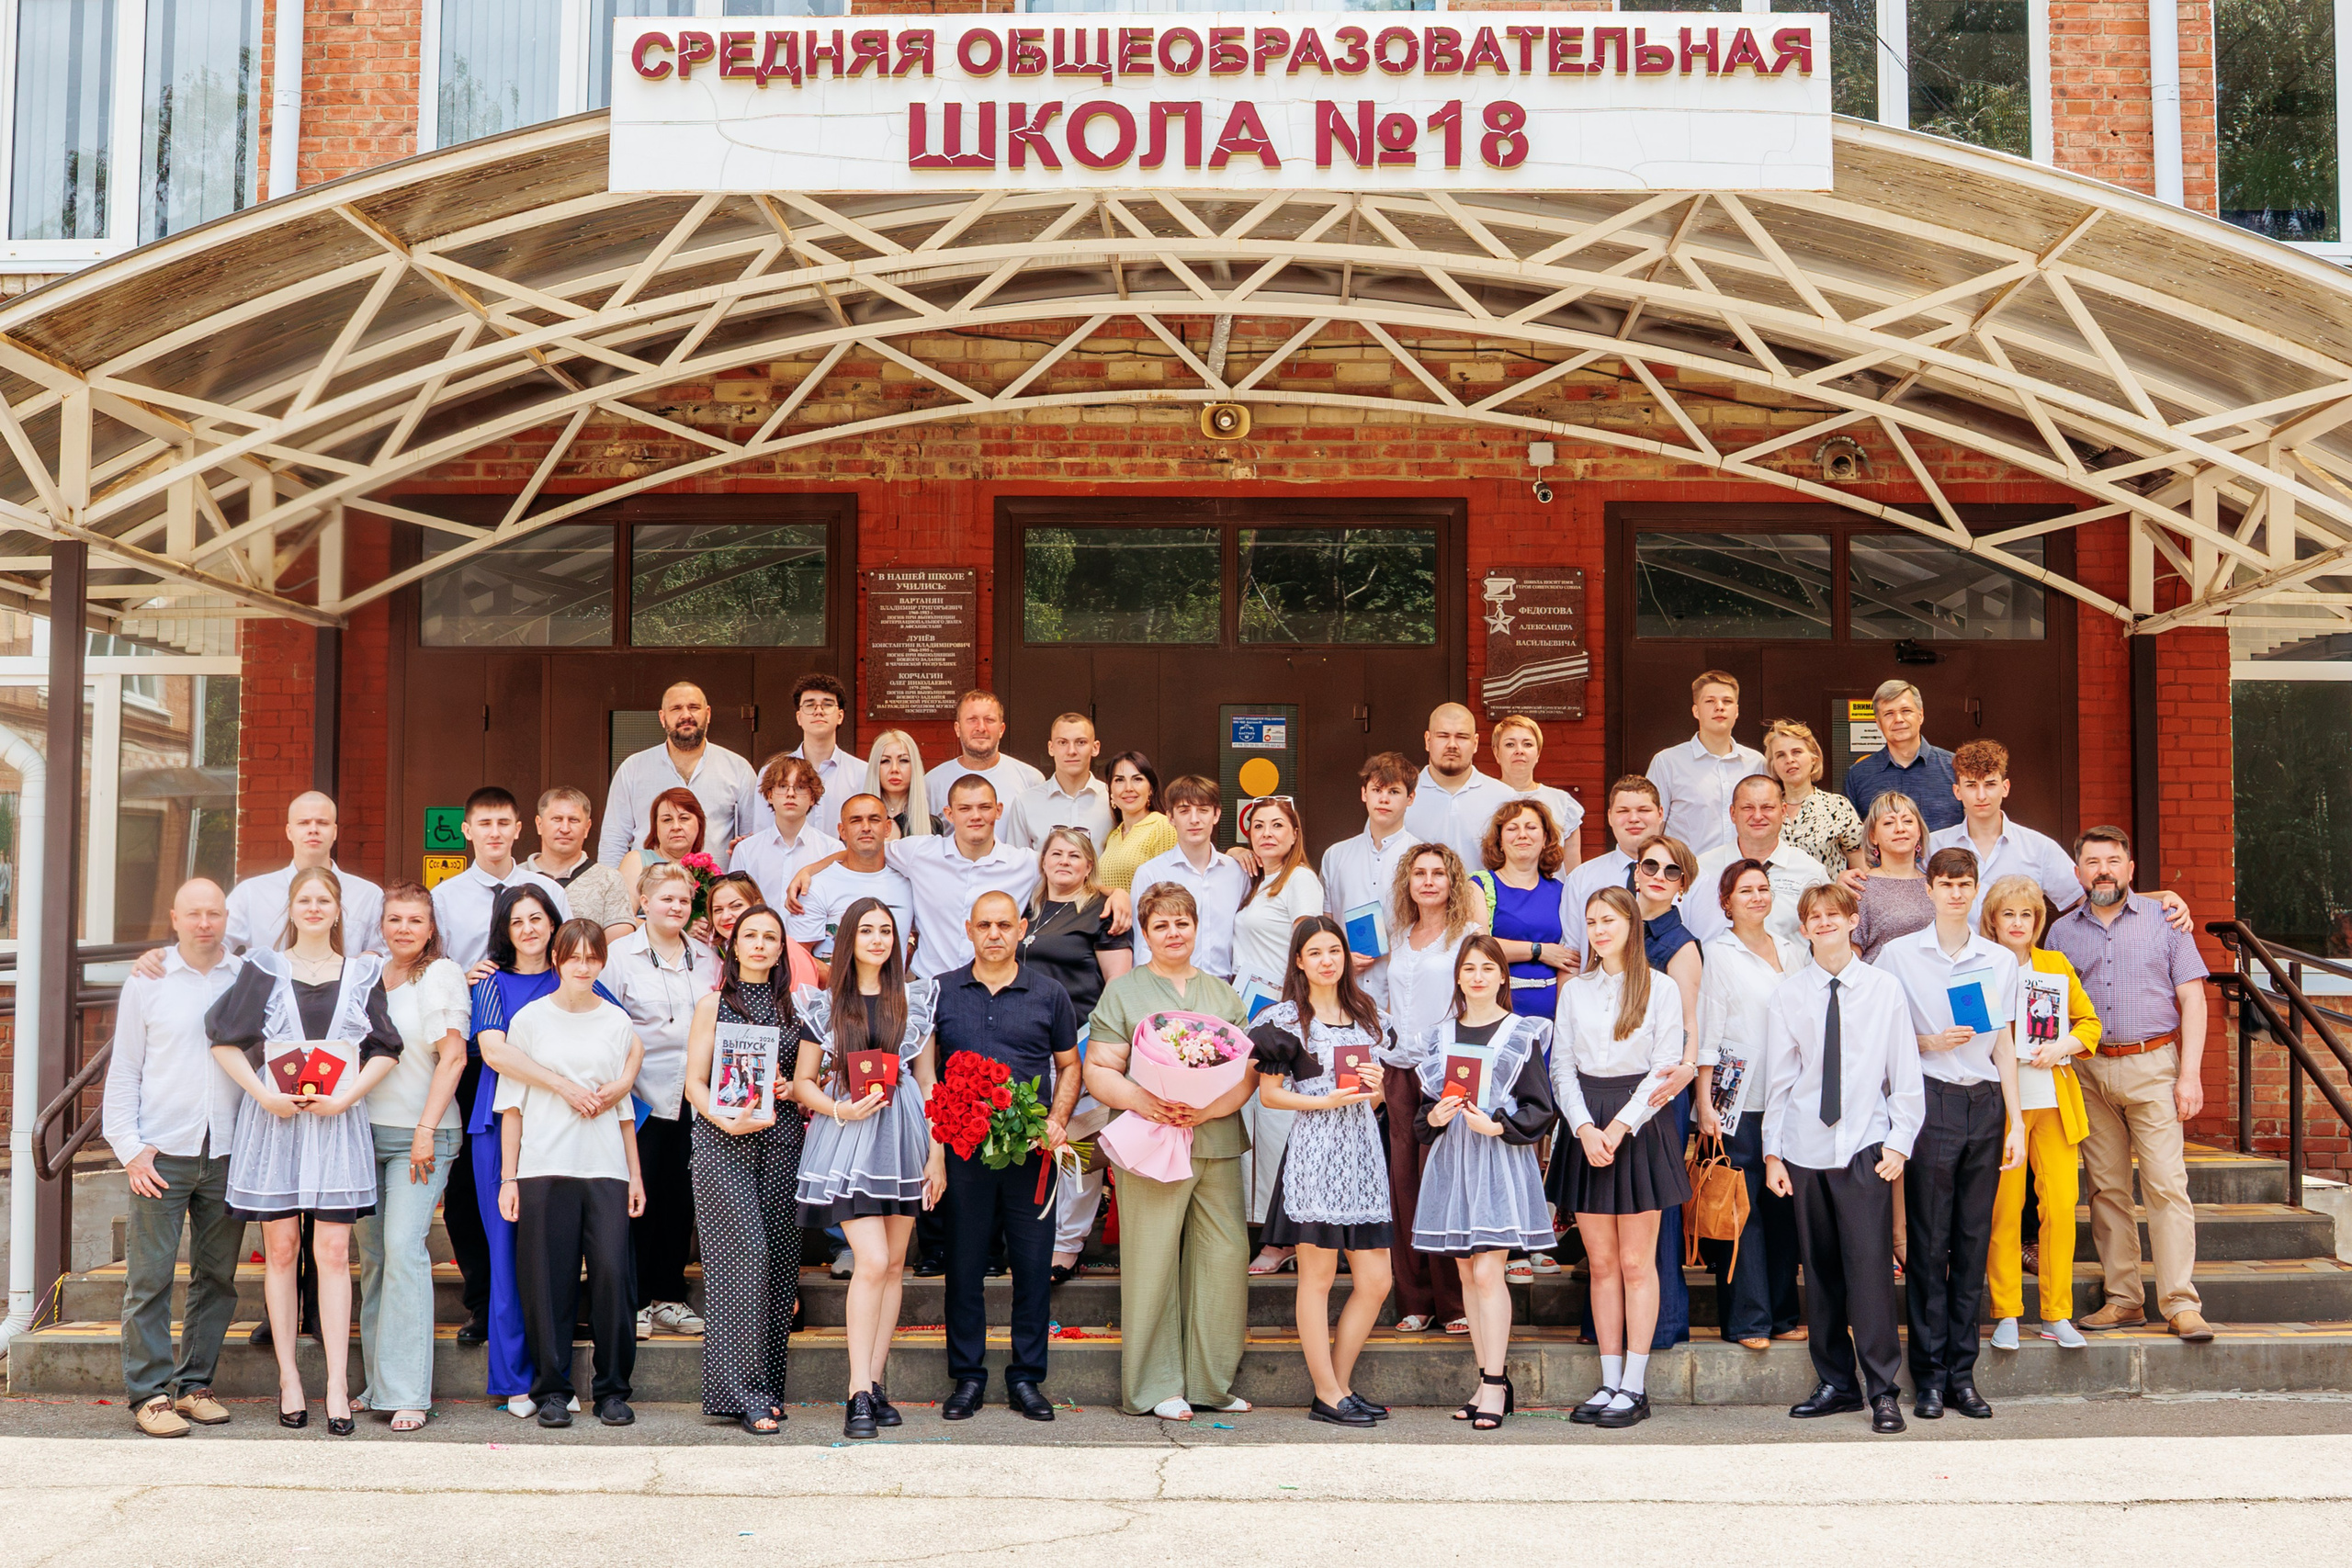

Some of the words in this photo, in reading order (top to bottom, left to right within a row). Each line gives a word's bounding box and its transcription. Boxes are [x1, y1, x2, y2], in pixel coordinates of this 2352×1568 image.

[631, 28, 935, 88] СРЕДНЯЯ
[957, 27, 1814, 87] ОБЩЕОБРАЗОВАТЕЛЬНАЯ
[908, 100, 1282, 171] ШКОЛА
[1315, 98, 1530, 171] №18
[887, 572, 925, 581] НАШЕЙ
[896, 582, 946, 591] УЧИЛИСЬ:
[1518, 606, 1574, 615] ФЕДОТОВА
[722, 1039, 767, 1052] ВЫПУСК
